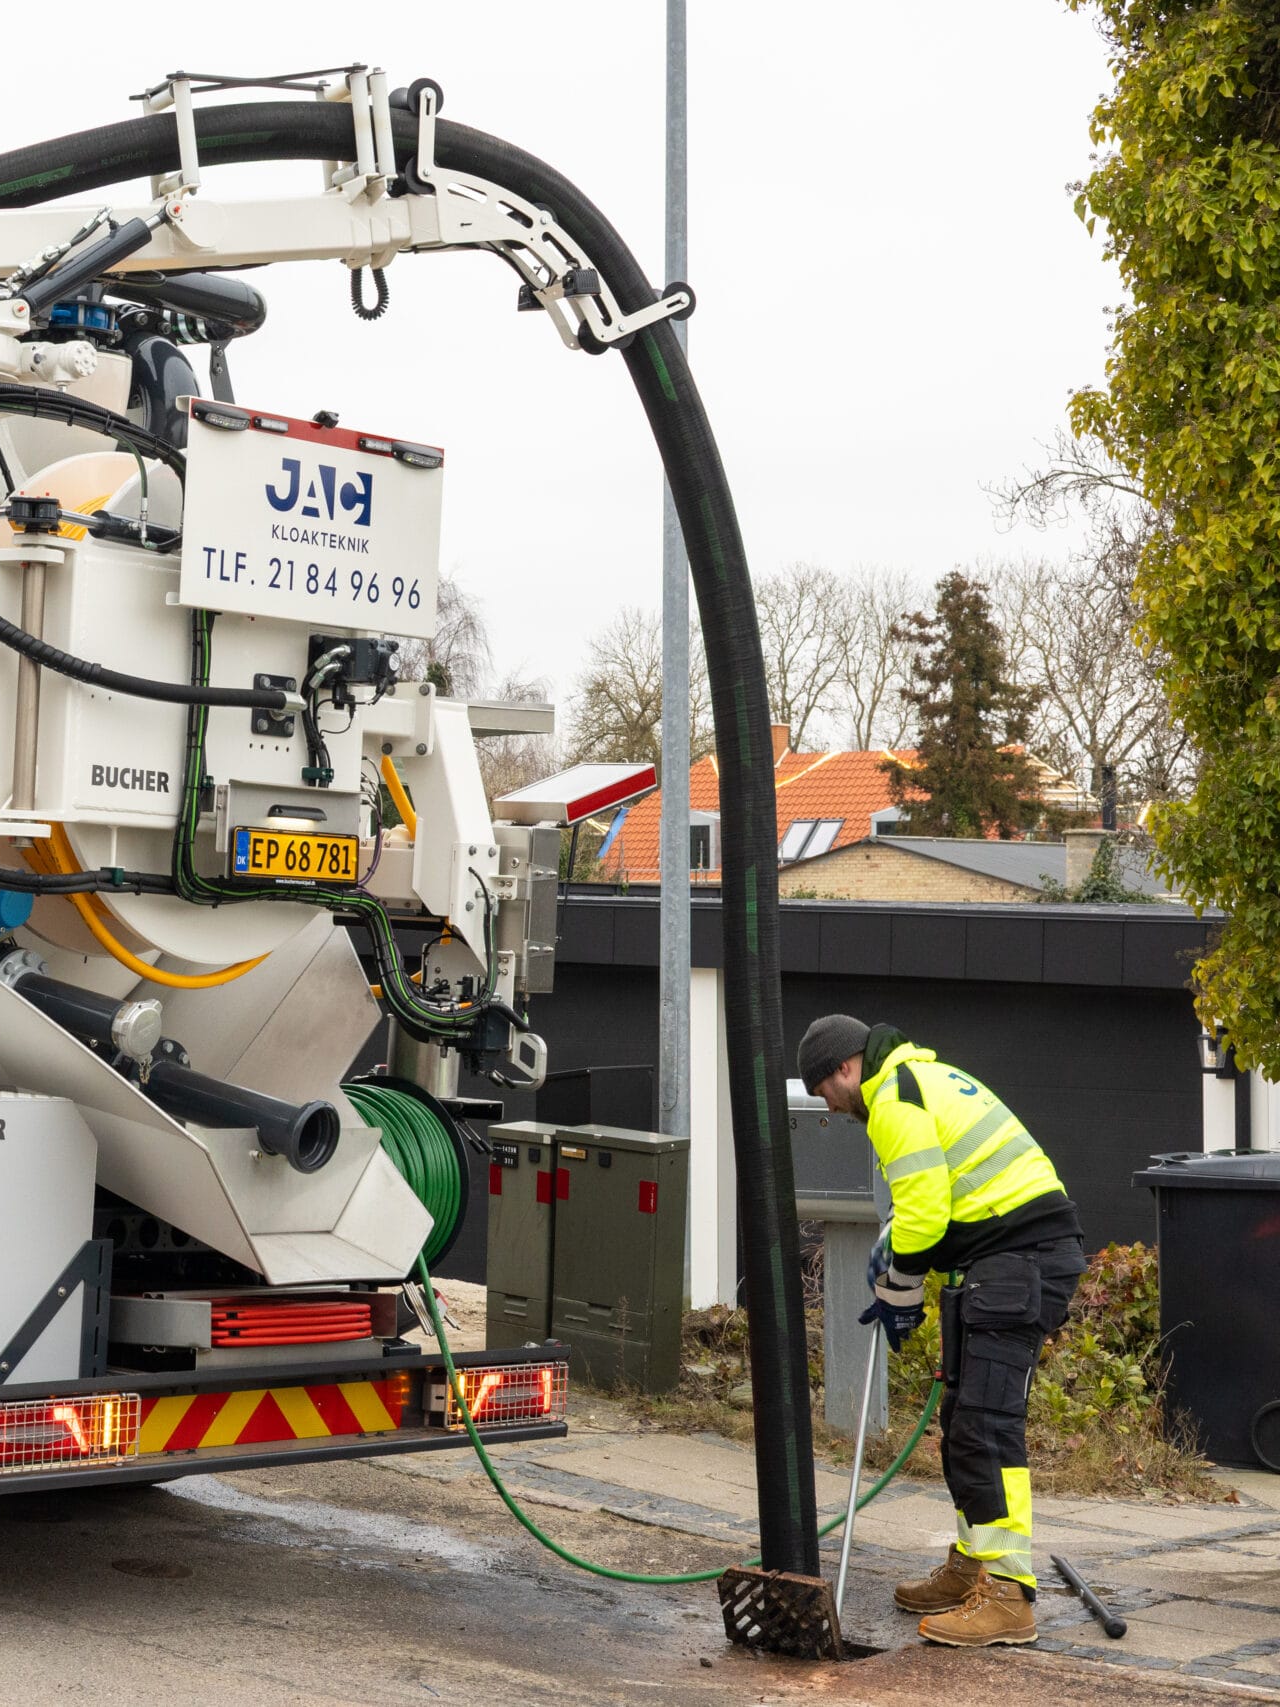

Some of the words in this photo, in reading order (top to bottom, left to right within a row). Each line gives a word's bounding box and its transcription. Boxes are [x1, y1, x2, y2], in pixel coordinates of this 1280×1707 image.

[265, 458, 373, 527] JAC
[271, 523, 369, 554] KLOAKTEKNIK
[203, 546, 256, 585] TLF.
[351, 570, 379, 604] 96
[392, 577, 421, 610] 96
[91, 764, 169, 793] BUCHER
[236, 855, 246, 865] DK
[251, 838, 279, 869] EP
[285, 840, 311, 872] 68
[317, 842, 351, 875] 781
